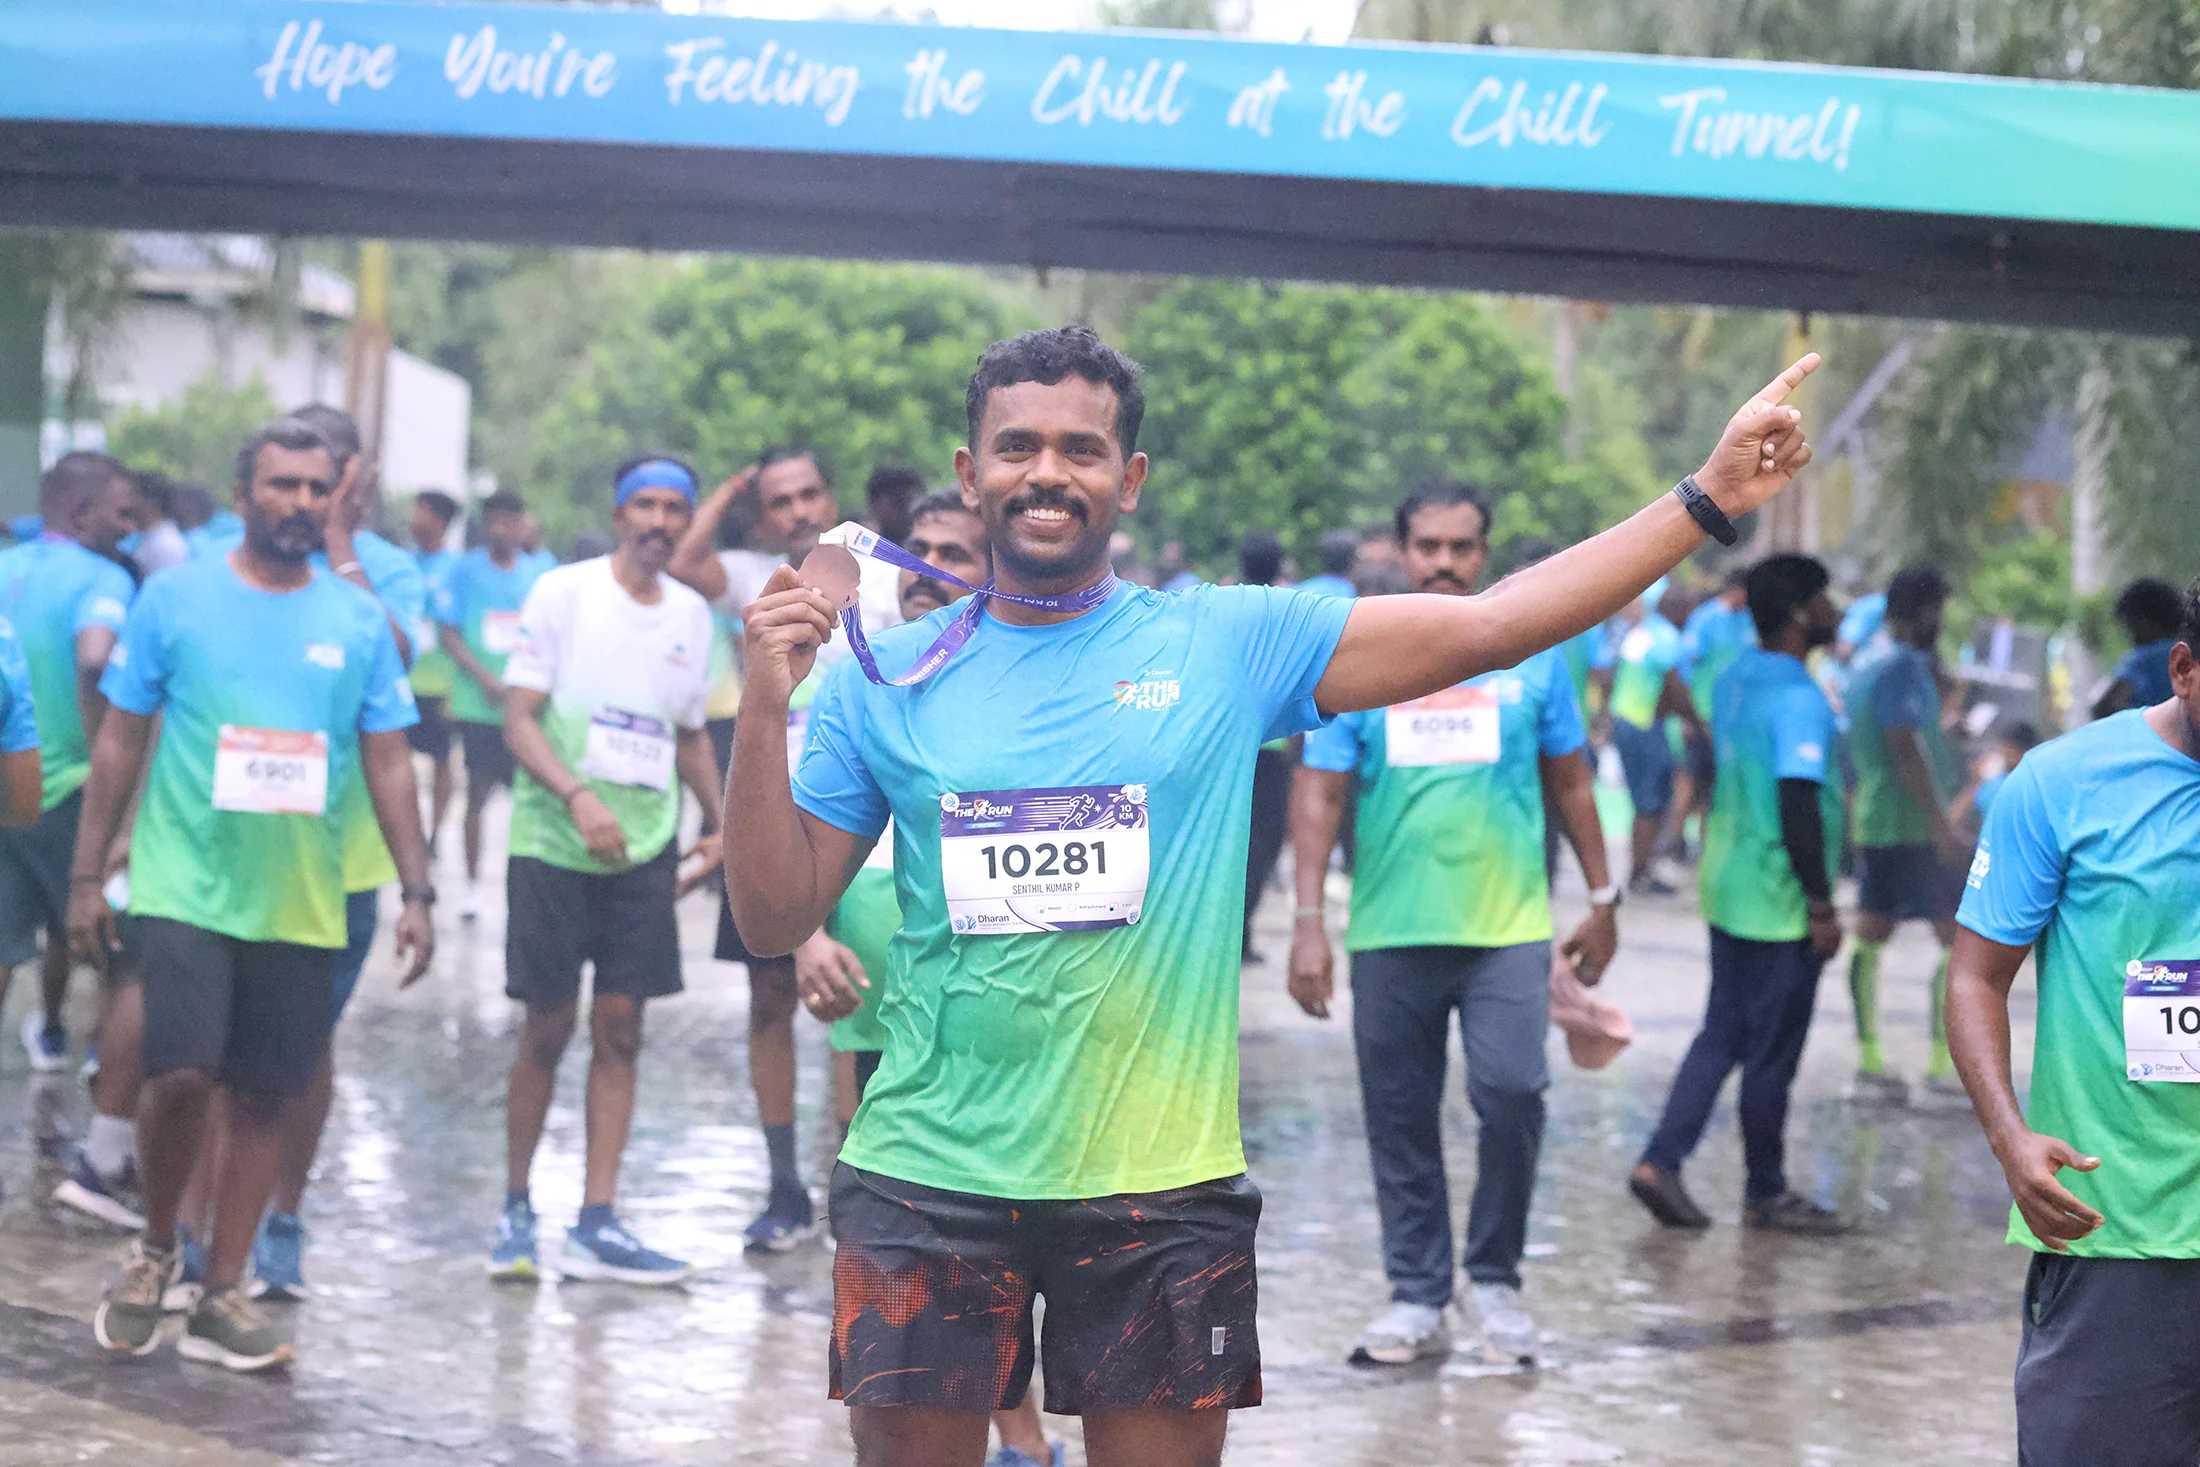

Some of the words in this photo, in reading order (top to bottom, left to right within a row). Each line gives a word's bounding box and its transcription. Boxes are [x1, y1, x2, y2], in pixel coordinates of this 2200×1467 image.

[257, 19, 396, 104] Hope
[444, 24, 618, 99] You're
[664, 36, 860, 127] Feeling
[903, 48, 984, 119] the
[1032, 56, 1190, 127] Chill
[1227, 67, 1289, 137] at
[1322, 71, 1407, 140] the
[1450, 77, 1608, 149] Chill
[1660, 87, 1861, 172] Tunnel!
[905, 648, 949, 684] FINISHER
[1140, 680, 1179, 694] THE
[1136, 685, 1180, 710] RUN
[1411, 716, 1475, 736] 6096
[245, 759, 307, 783] 6901
[954, 808, 975, 818] THE
[987, 805, 1013, 816] RUN
[1120, 804, 1132, 812] 10
[1119, 812, 1134, 820] KM
[981, 841, 1106, 879] 10281
[1012, 884, 1044, 895] SENTHIL
[1046, 883, 1073, 893] KUMAR
[1074, 882, 1080, 892] P
[978, 914, 1010, 923] Dharan
[2165, 972, 2189, 981] RUN
[2160, 1006, 2200, 1034] 10
[2155, 1063, 2185, 1071] Dharan
